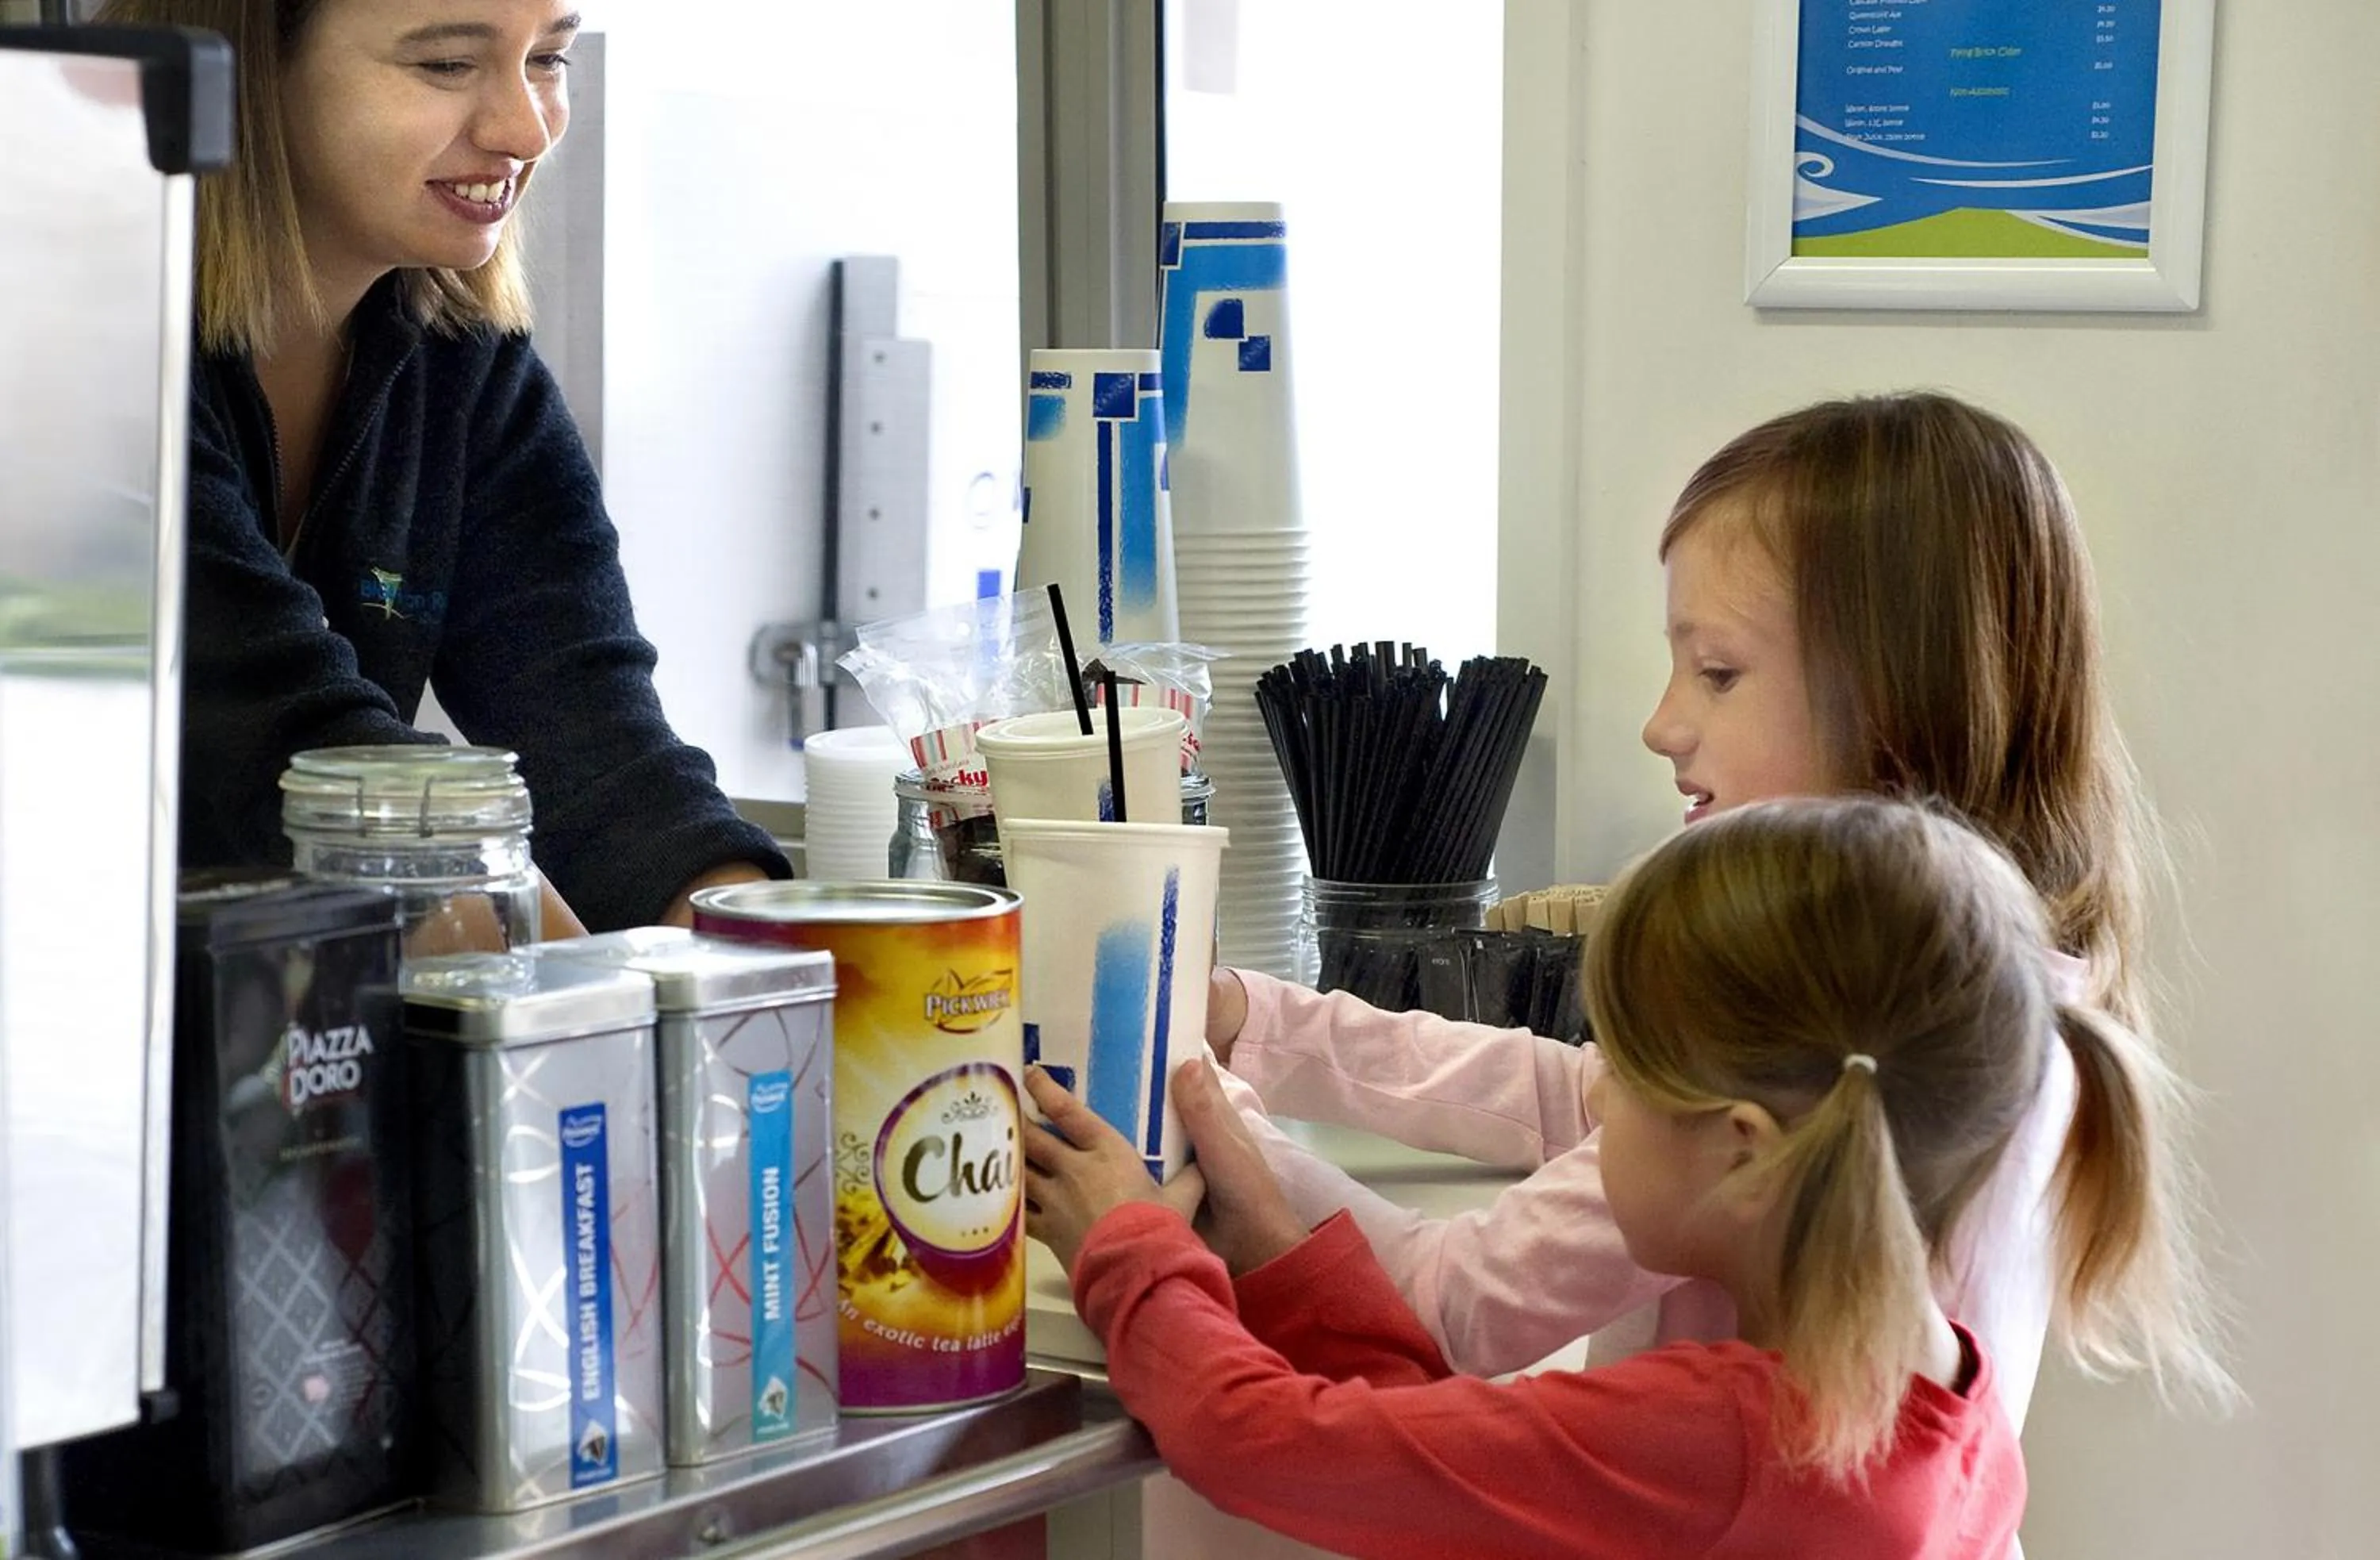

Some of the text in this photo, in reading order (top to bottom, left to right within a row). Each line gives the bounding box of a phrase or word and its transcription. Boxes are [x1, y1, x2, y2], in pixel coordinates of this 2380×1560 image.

[288, 1024, 374, 1066] PIAZZA
[902, 1127, 1014, 1204] Chai
[575, 1162, 598, 1297] BREAKFAST
[762, 1166, 781, 1321] MINT FUSION
[582, 1302, 601, 1401] ENGLISH
[863, 1318, 926, 1349] exotic
[932, 1335, 961, 1352] tea
